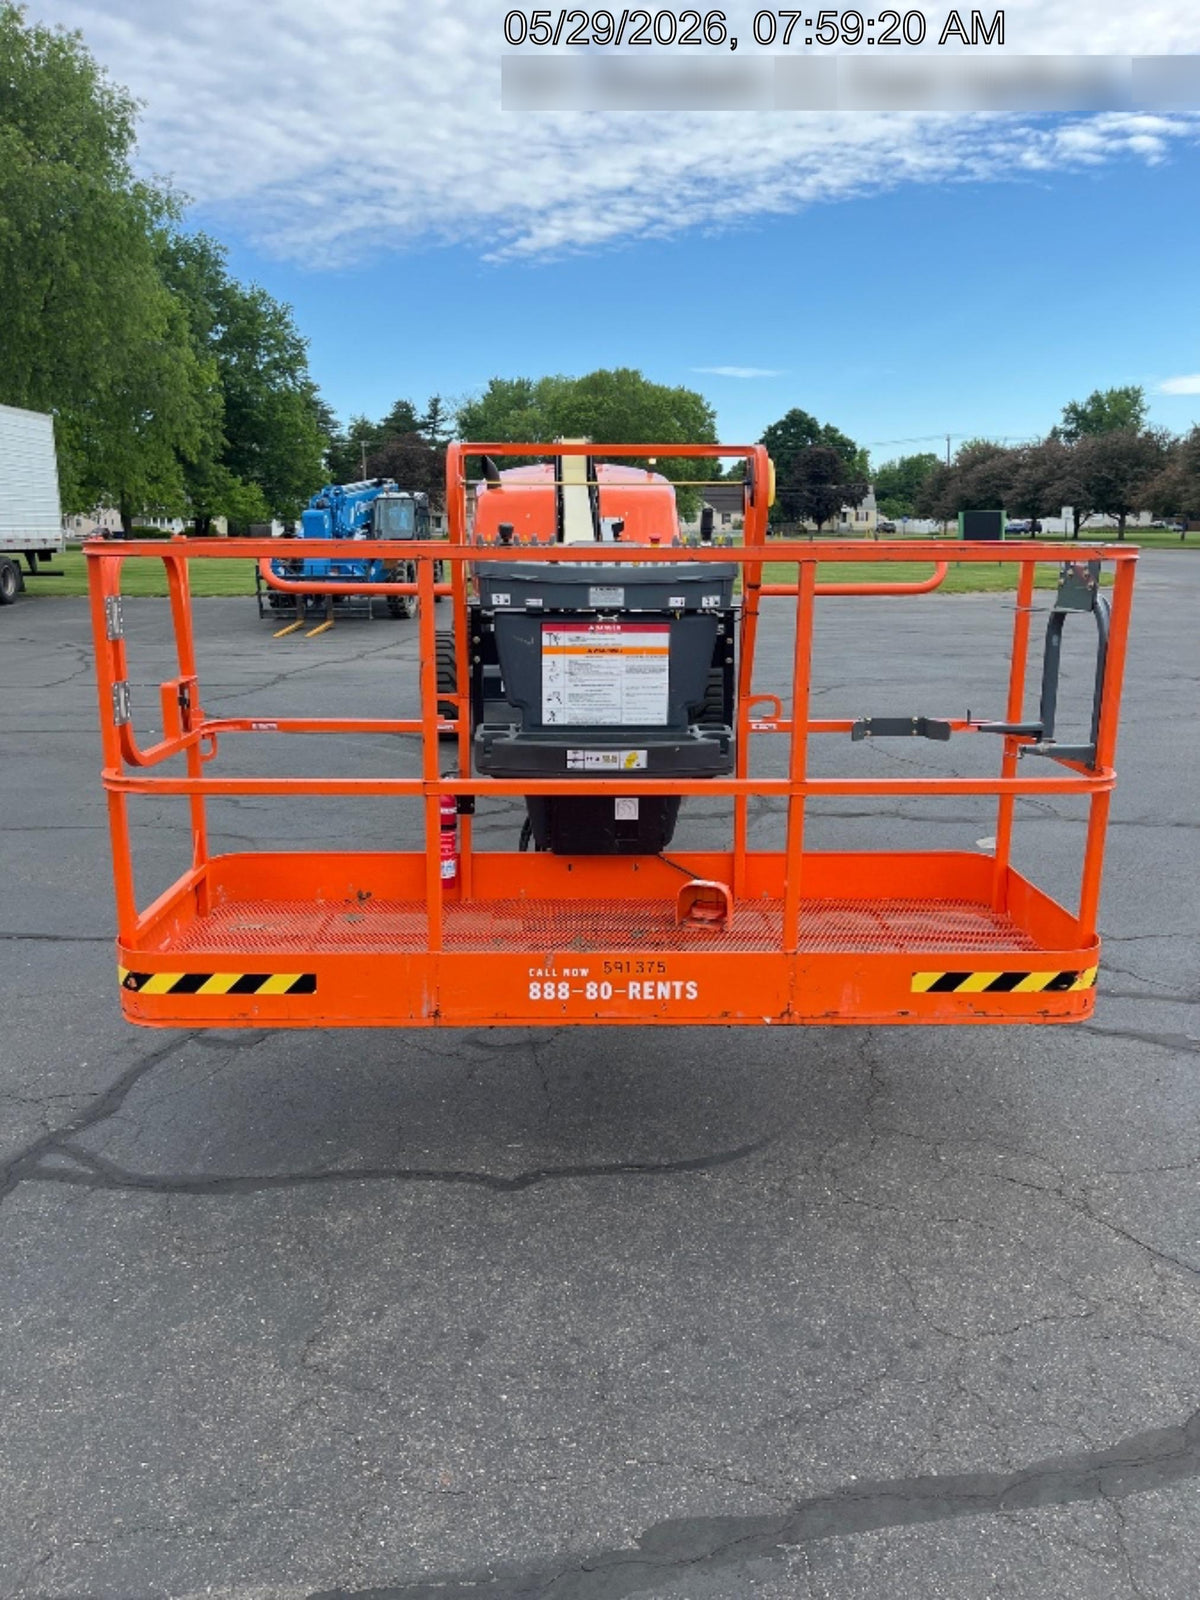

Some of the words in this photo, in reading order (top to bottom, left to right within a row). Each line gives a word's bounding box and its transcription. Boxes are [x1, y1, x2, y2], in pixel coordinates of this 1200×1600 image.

[528, 968, 557, 977] CALL
[563, 968, 589, 977] NOW
[603, 961, 666, 973] 591375
[529, 981, 698, 1000] 888-80-RENTS
